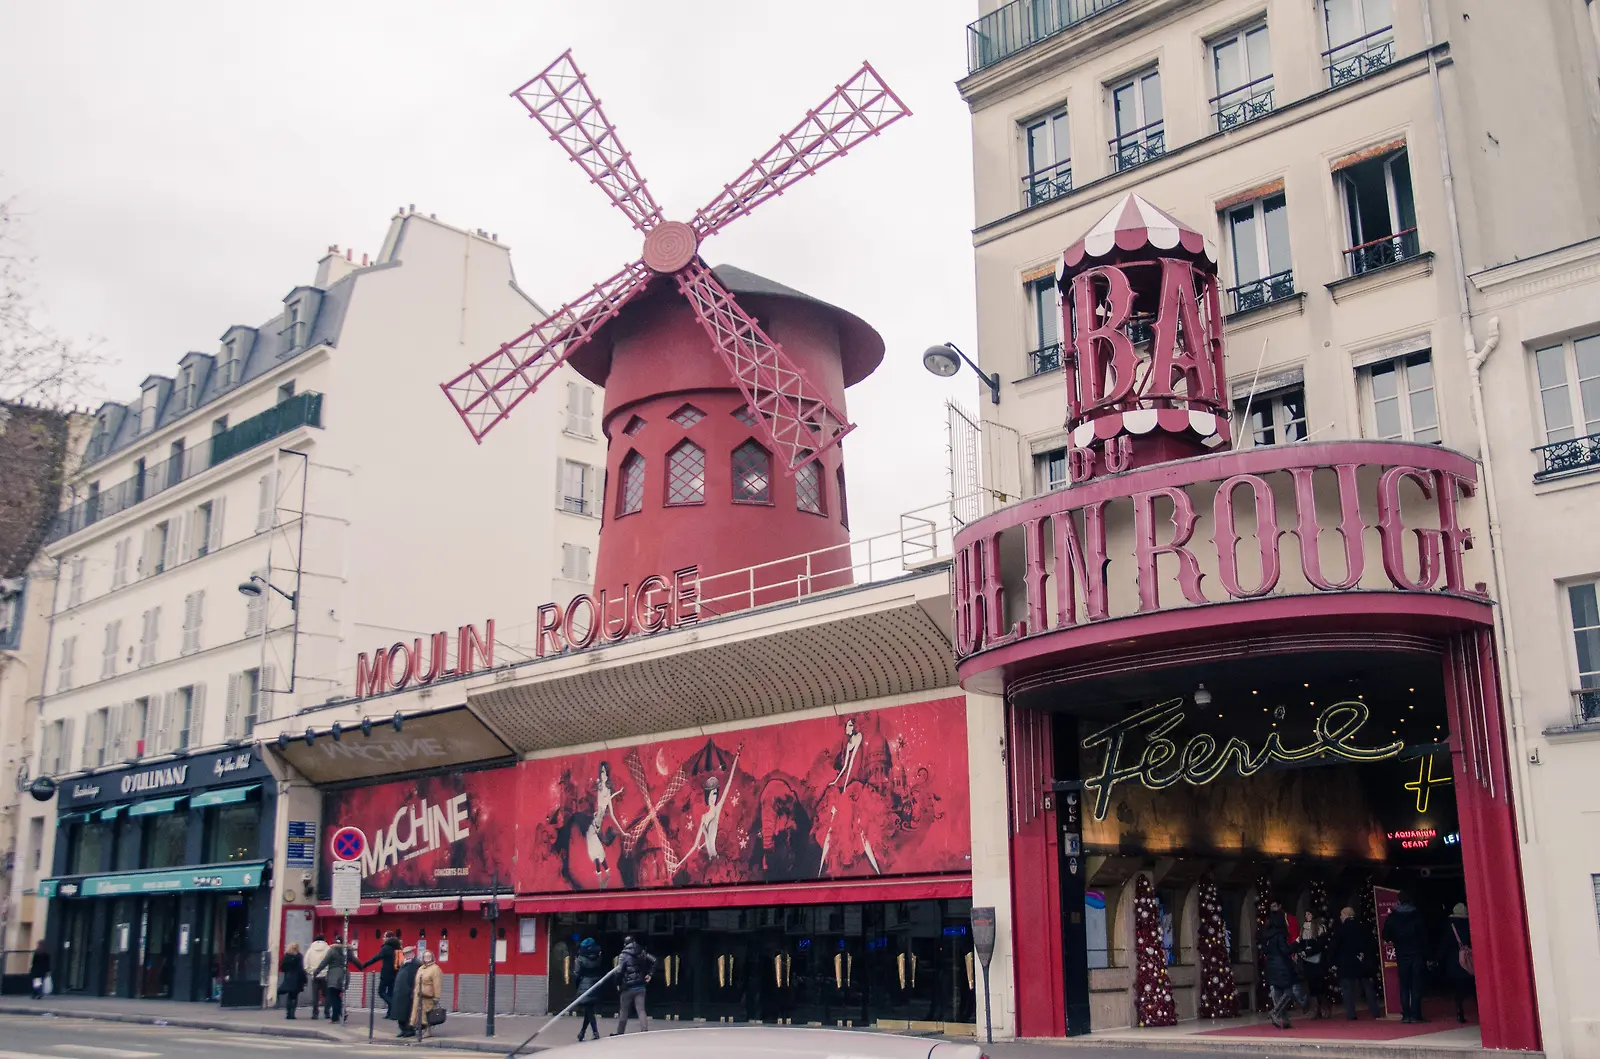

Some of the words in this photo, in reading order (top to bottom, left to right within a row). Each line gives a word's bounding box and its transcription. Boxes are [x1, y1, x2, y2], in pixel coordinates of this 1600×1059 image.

[1071, 257, 1228, 413] BA
[1069, 435, 1133, 483] DU
[1131, 463, 1489, 613] ROUGE
[355, 618, 496, 697] MOULIN
[536, 564, 702, 657] ROUGE
[1082, 697, 1404, 821] Féerie
[361, 793, 470, 879] MACHINE
